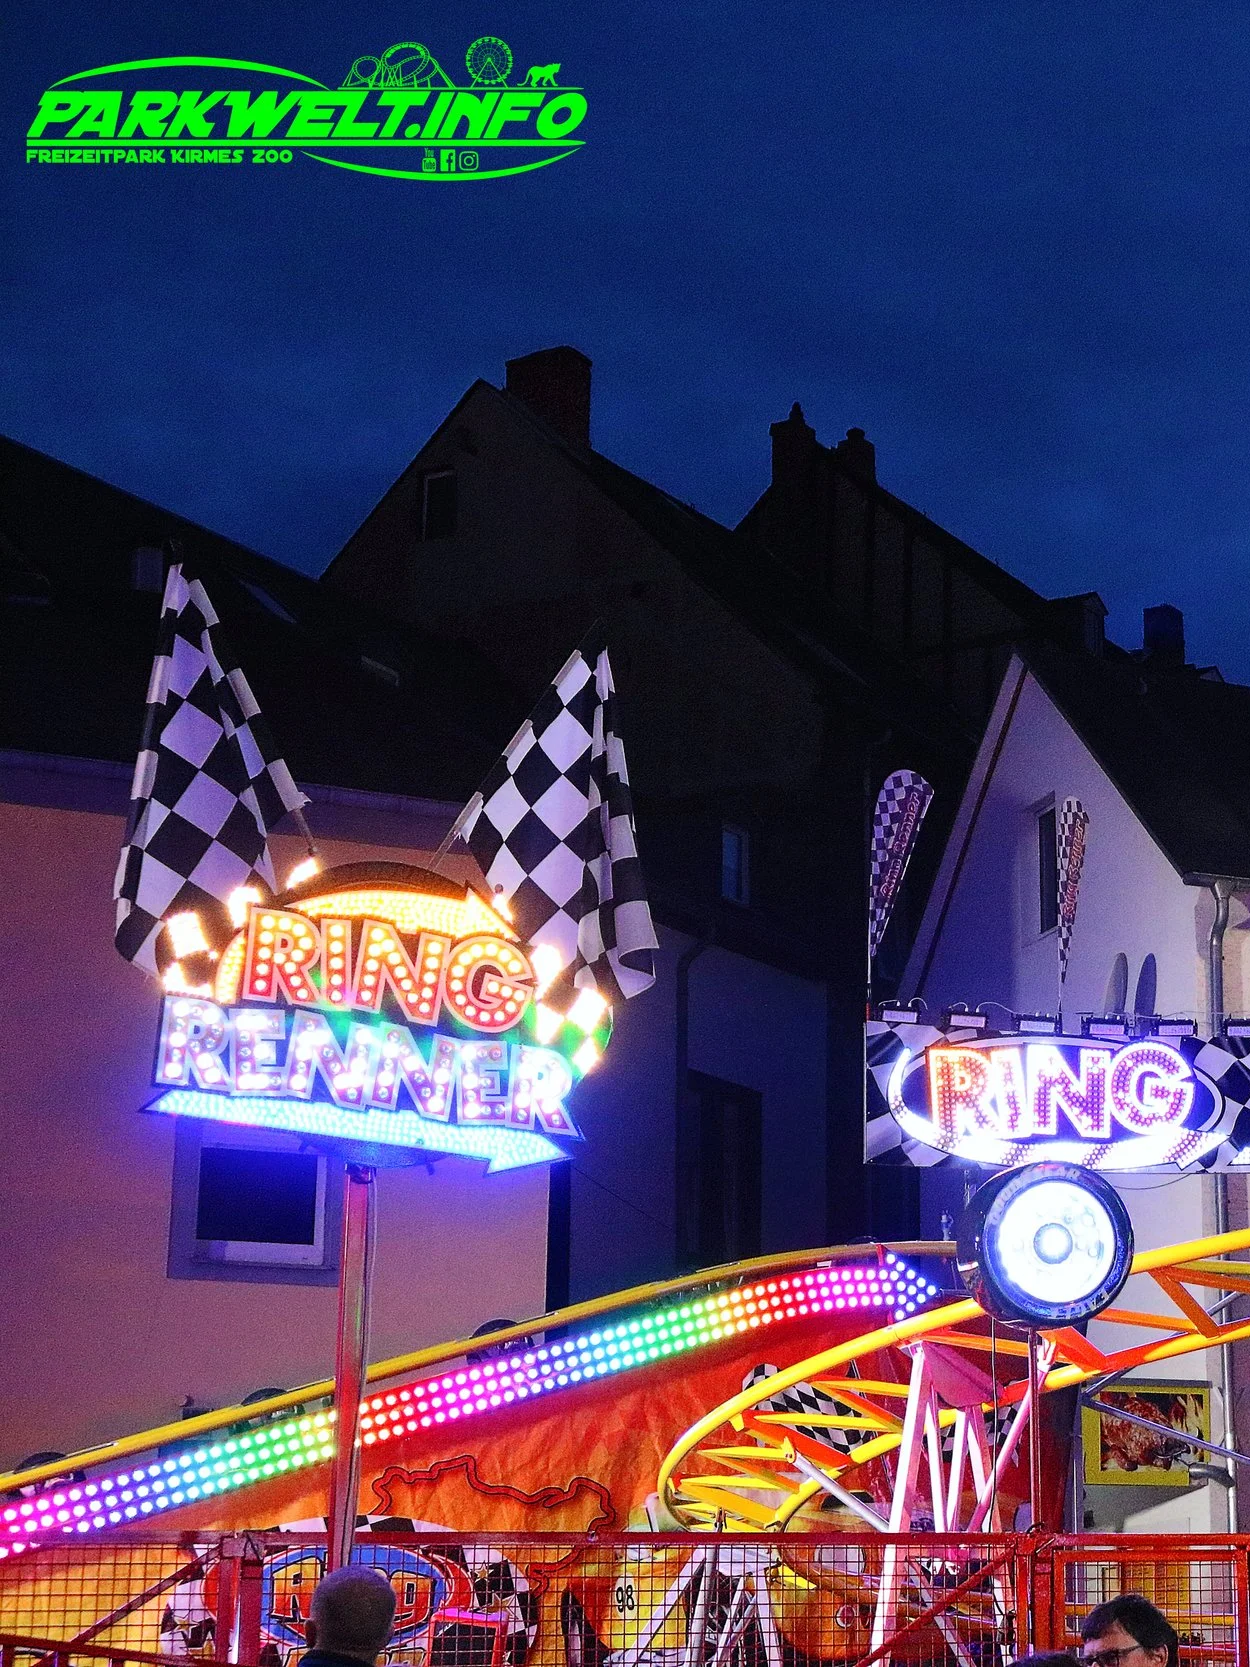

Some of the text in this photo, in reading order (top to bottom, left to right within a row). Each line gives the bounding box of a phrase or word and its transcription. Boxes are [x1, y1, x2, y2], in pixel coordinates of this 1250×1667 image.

[243, 906, 537, 1033] RING
[155, 995, 580, 1137] RENNER
[926, 1041, 1194, 1138] RING
[616, 1584, 635, 1613] 98
